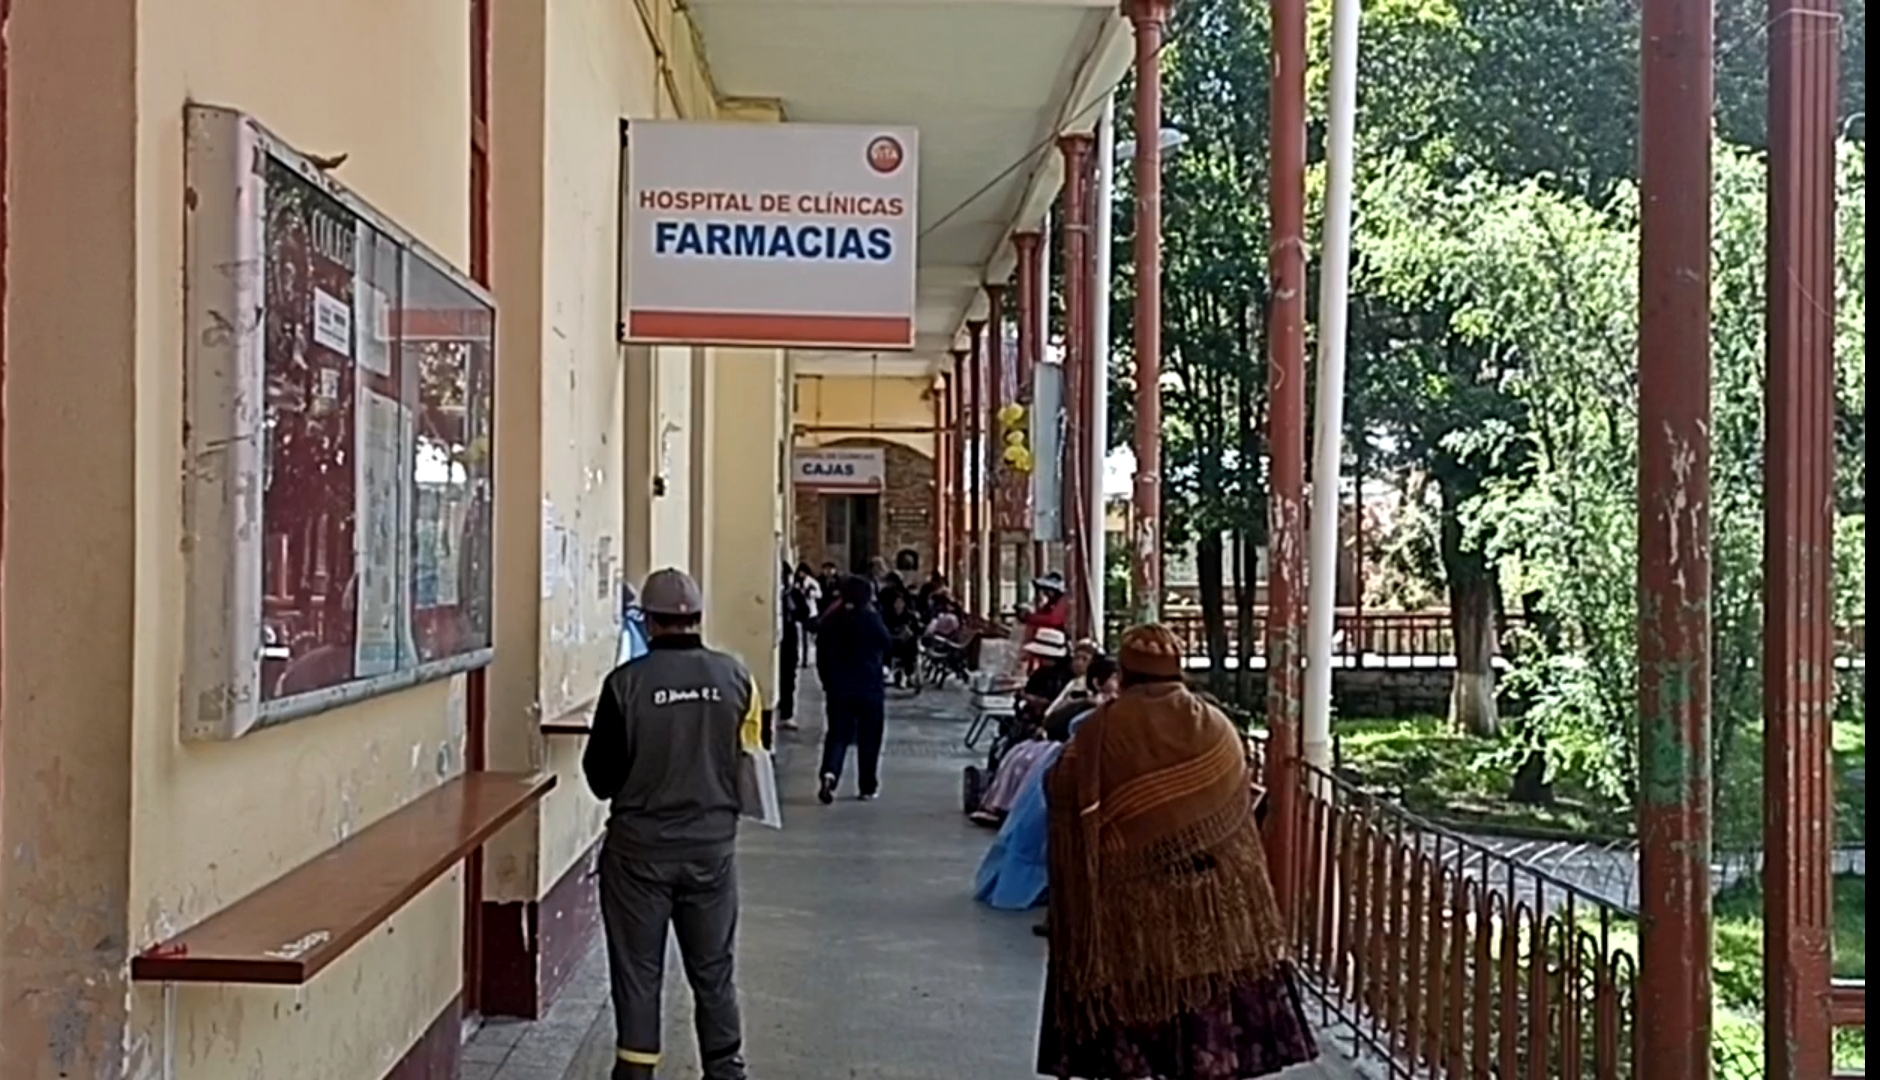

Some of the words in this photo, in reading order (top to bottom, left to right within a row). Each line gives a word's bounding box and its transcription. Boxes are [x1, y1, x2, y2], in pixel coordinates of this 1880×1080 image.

[639, 190, 753, 212] HOSPITAL
[760, 194, 791, 212] DE
[798, 191, 904, 216] CLÍNICAS
[655, 221, 893, 260] FARMACIAS
[802, 463, 854, 475] CAJAS
